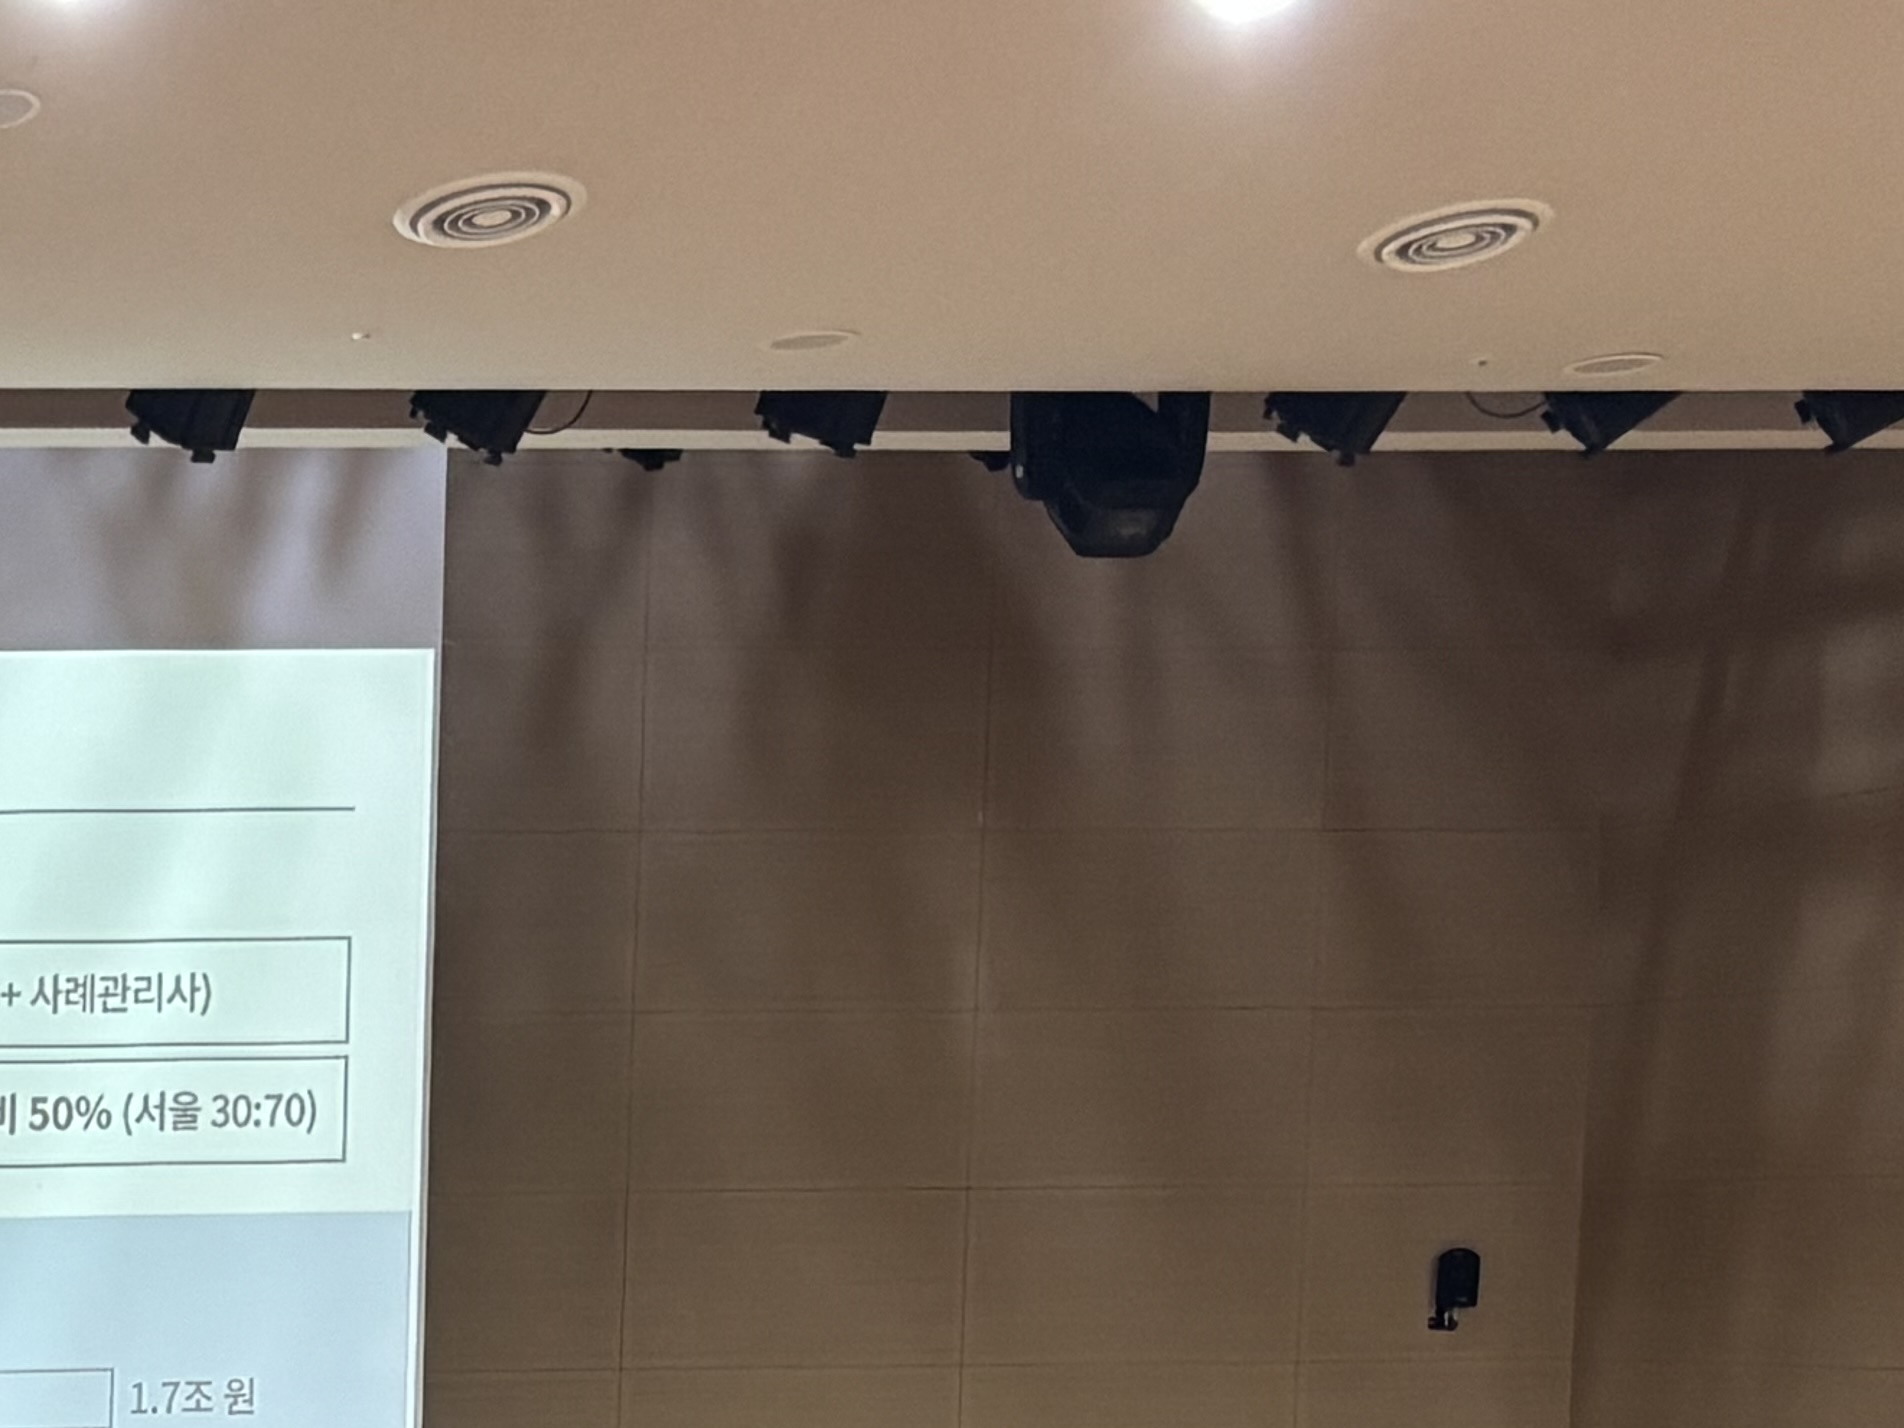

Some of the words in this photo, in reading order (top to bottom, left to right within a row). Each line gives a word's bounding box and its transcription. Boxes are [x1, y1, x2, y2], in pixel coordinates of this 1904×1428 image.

[0, 982, 22, 1007] +
[29, 971, 212, 1017] 사례관리사)
[28, 1093, 113, 1132] 50%
[122, 1090, 203, 1137] (서울
[210, 1088, 317, 1135] 30:70)
[130, 1380, 214, 1415] 1.7조
[223, 1376, 255, 1416] 원
